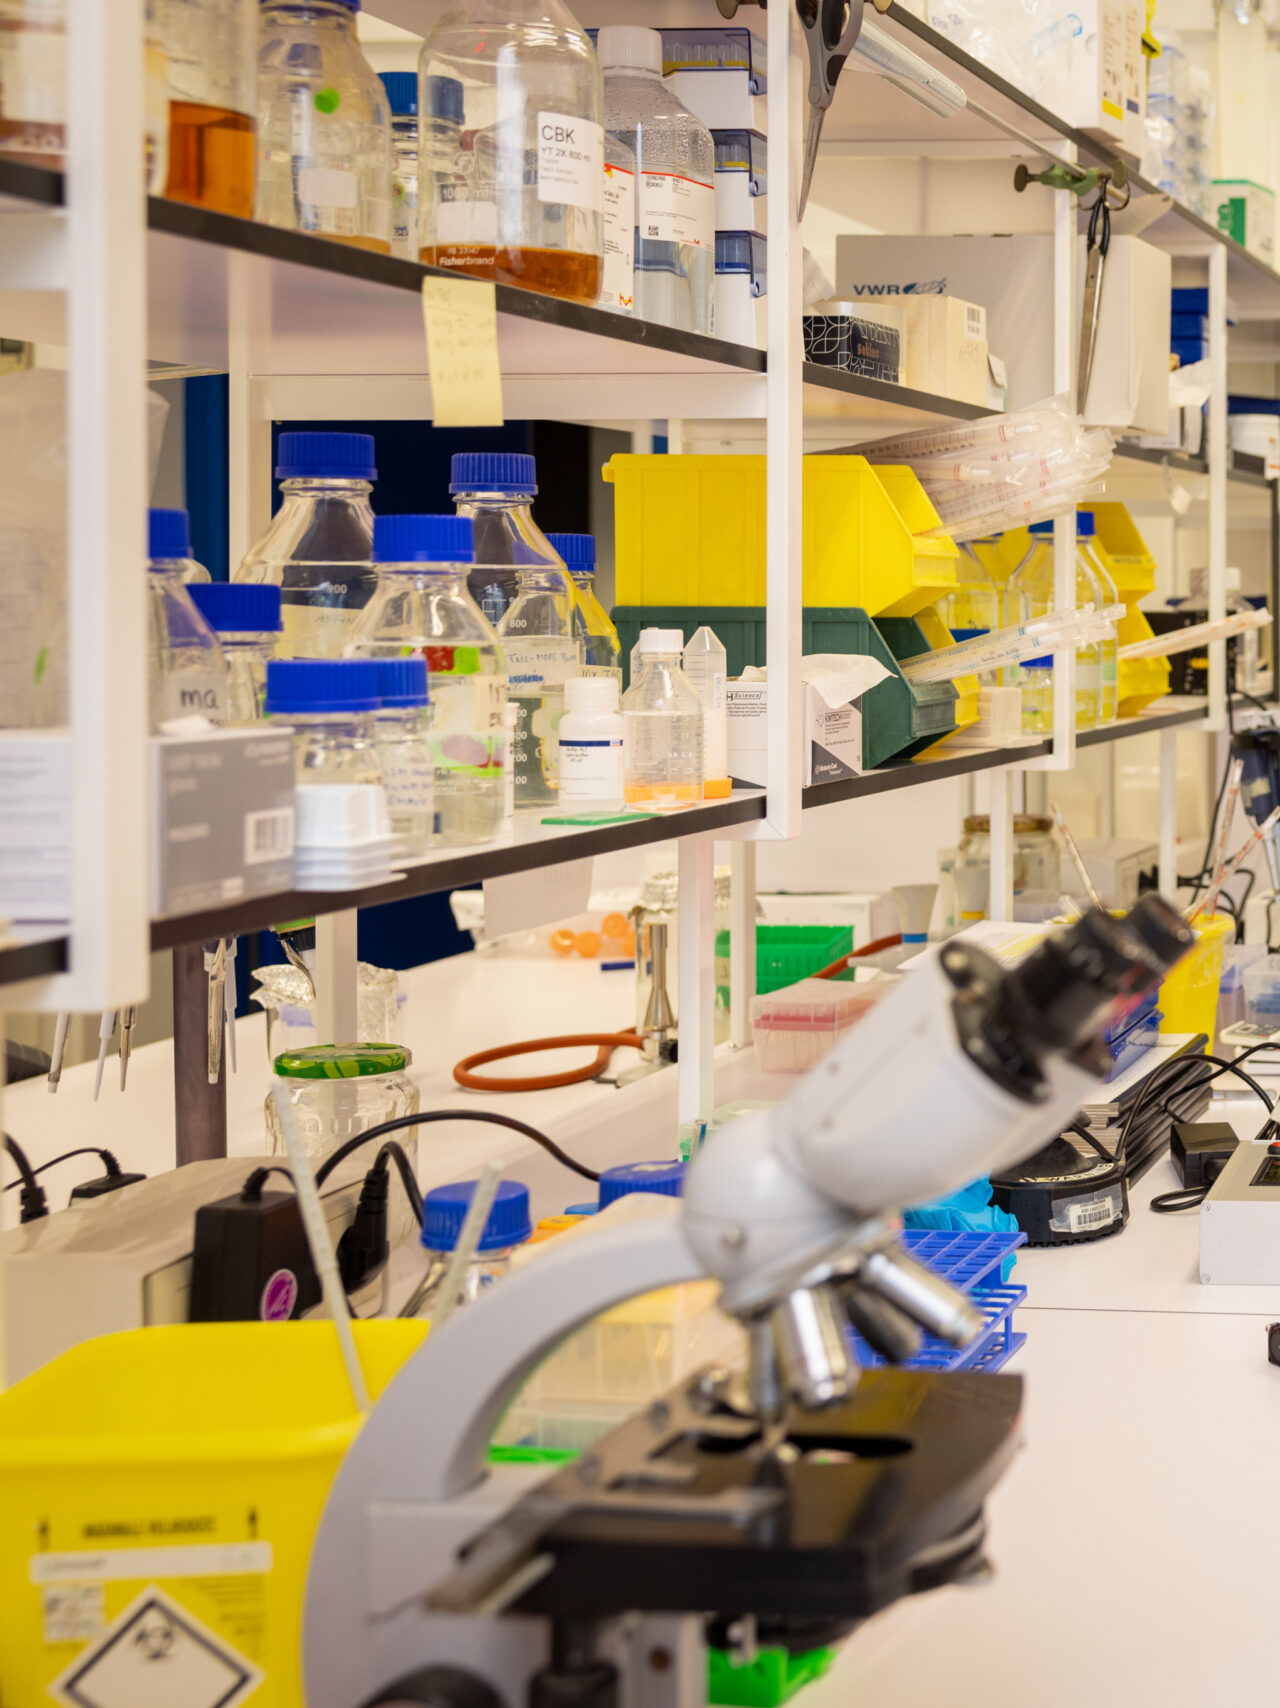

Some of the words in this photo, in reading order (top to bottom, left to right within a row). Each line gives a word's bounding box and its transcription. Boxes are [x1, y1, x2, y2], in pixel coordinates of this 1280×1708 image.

[541, 125, 576, 144] CBK
[440, 256, 496, 266] Fisherbrand
[853, 284, 900, 296] VWR
[509, 619, 527, 628] 800
